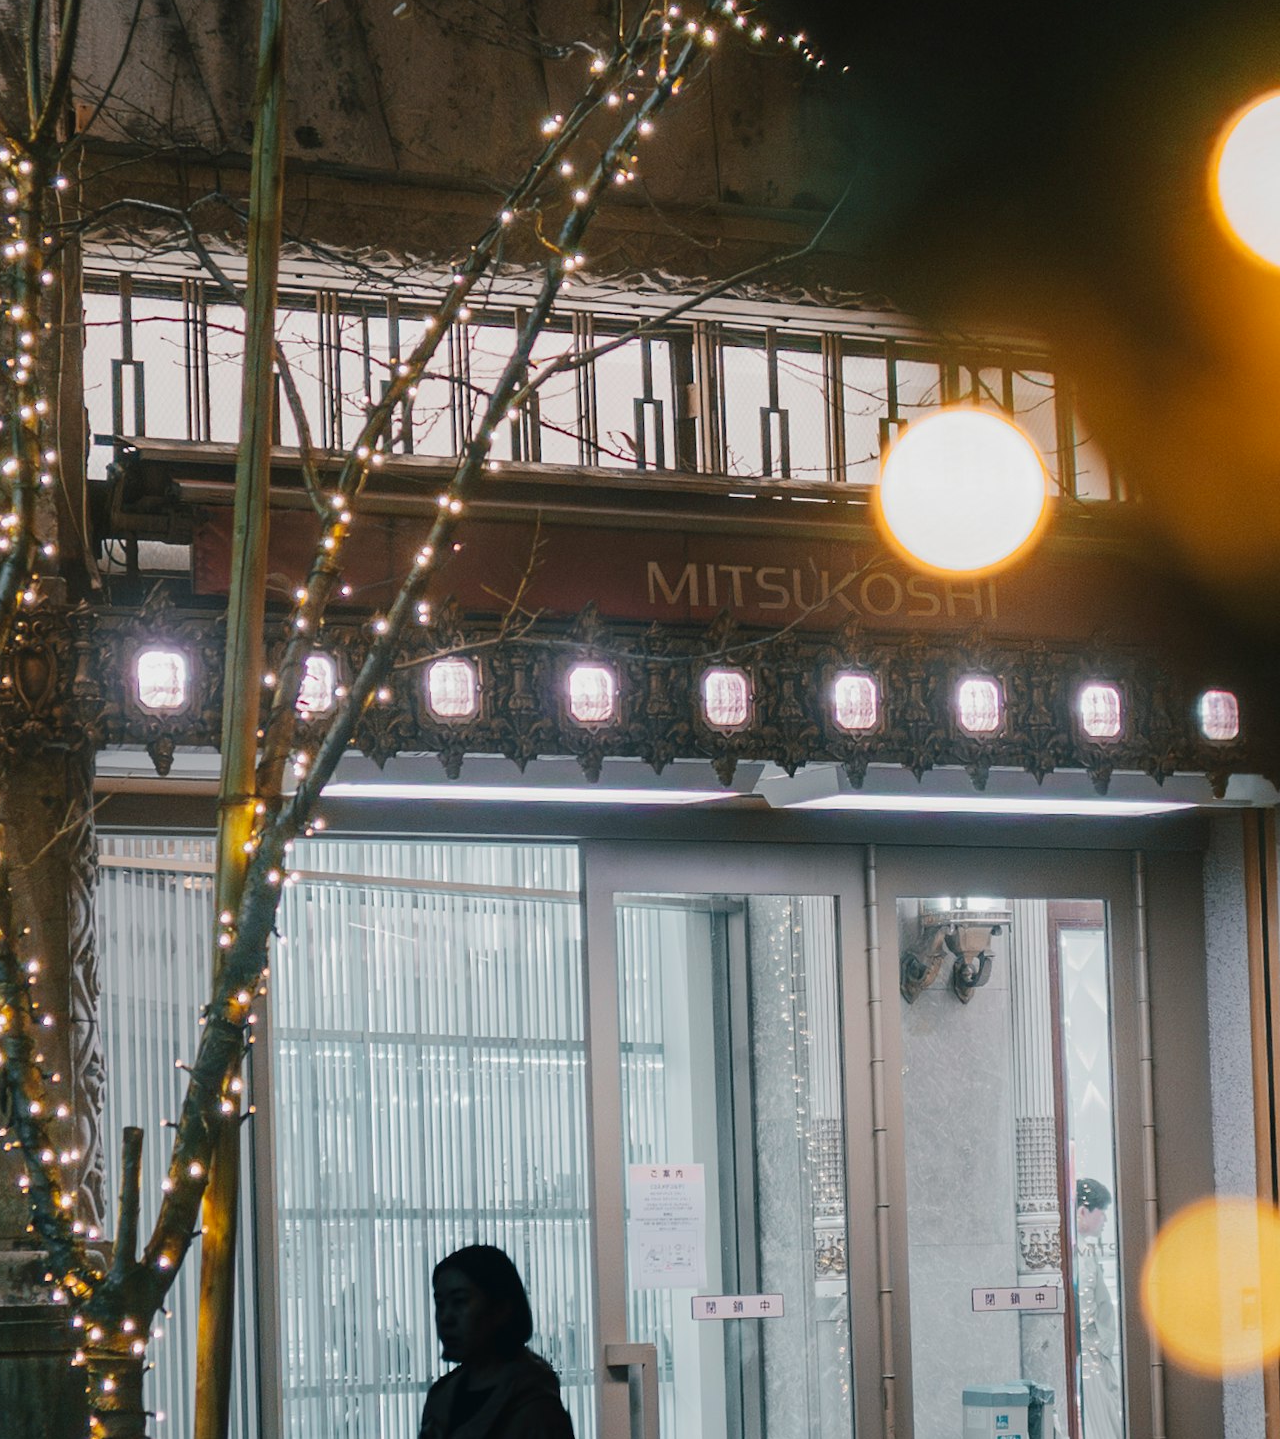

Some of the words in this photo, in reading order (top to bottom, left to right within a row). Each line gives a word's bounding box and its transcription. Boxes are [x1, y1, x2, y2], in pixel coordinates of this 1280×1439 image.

[646, 560, 999, 619] MITSUKOSHI
[650, 1169, 684, 1179] ご案内
[985, 1291, 1045, 1306] 閉鎖中
[705, 1299, 770, 1314] 閉鎖中
